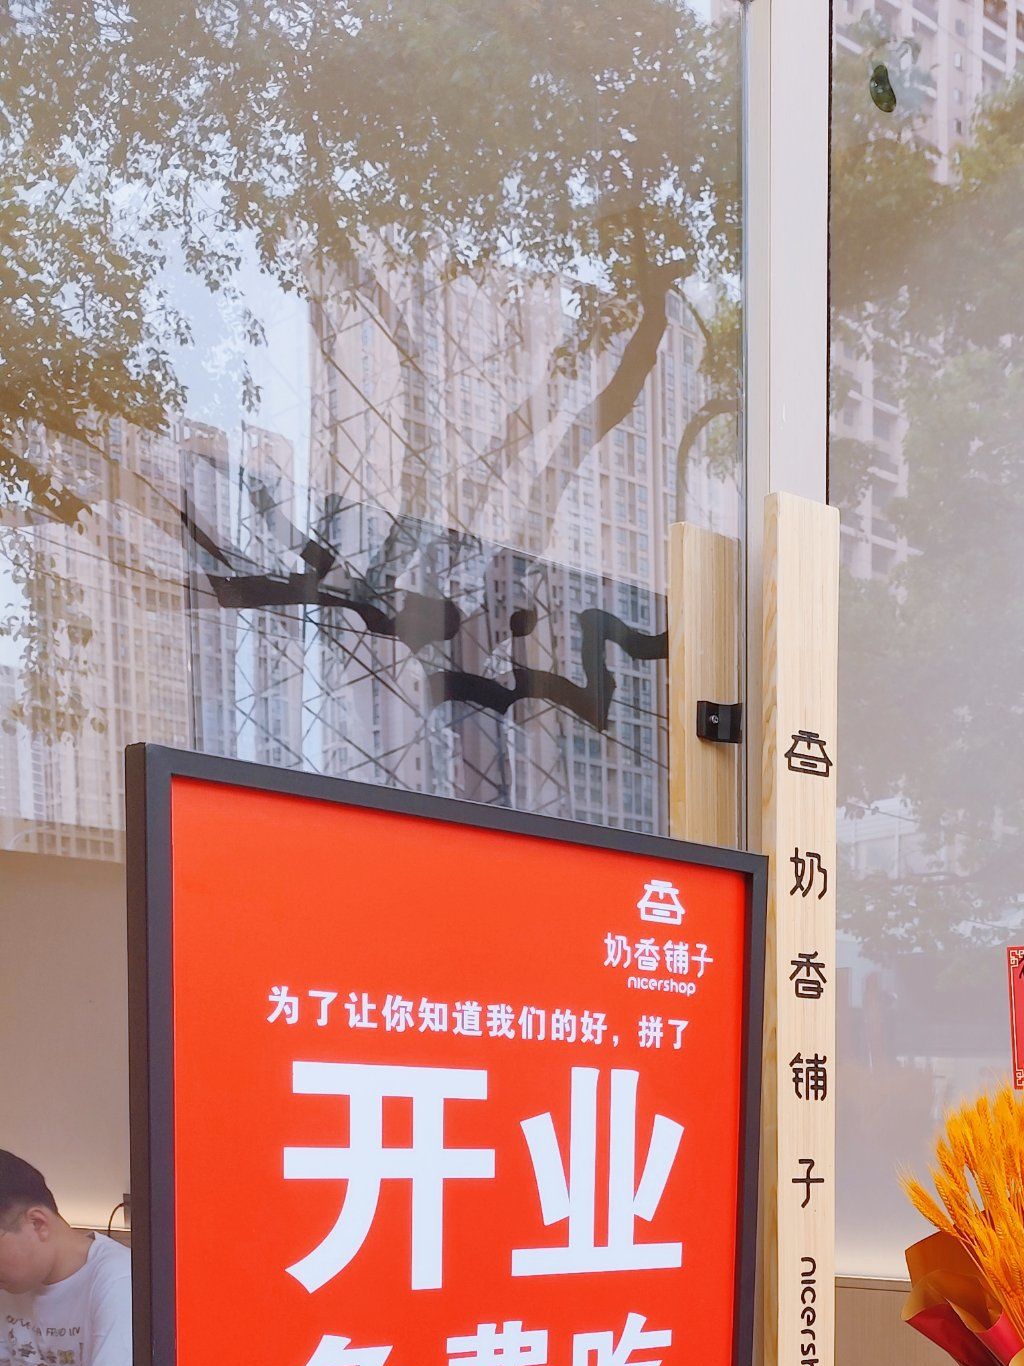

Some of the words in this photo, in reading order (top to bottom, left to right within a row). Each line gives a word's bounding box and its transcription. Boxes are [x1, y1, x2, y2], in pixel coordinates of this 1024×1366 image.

[604, 932, 714, 978] 奶香铺子
[627, 976, 696, 997] nicershop
[267, 985, 690, 1051] 为了让你知道我们的好，拼了
[789, 847, 828, 1208] 奶香铺子
[283, 1061, 685, 1294] 开业
